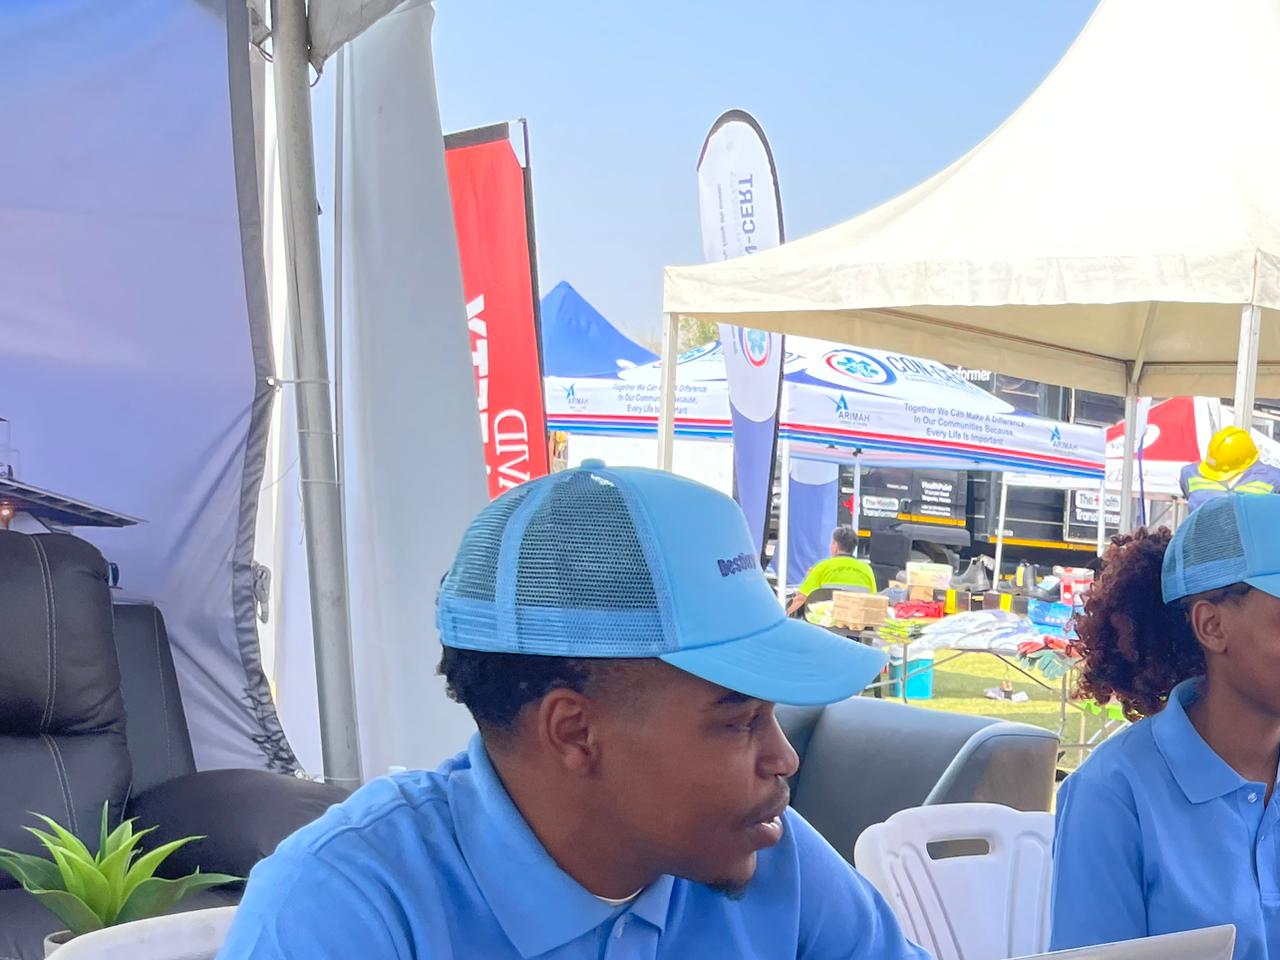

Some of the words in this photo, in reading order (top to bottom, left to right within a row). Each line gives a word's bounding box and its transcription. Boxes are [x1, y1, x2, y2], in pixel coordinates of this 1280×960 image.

[838, 411, 870, 422] ARIMAH
[904, 403, 936, 415] Together
[950, 409, 965, 417] Can
[966, 412, 985, 421] Make
[991, 415, 1025, 428] Difference
[914, 415, 921, 423] In
[923, 416, 936, 426] Our
[938, 420, 982, 432] Communities
[926, 428, 947, 440] Every
[949, 430, 962, 439] Life
[963, 432, 969, 440] Is
[971, 433, 1003, 445] Important
